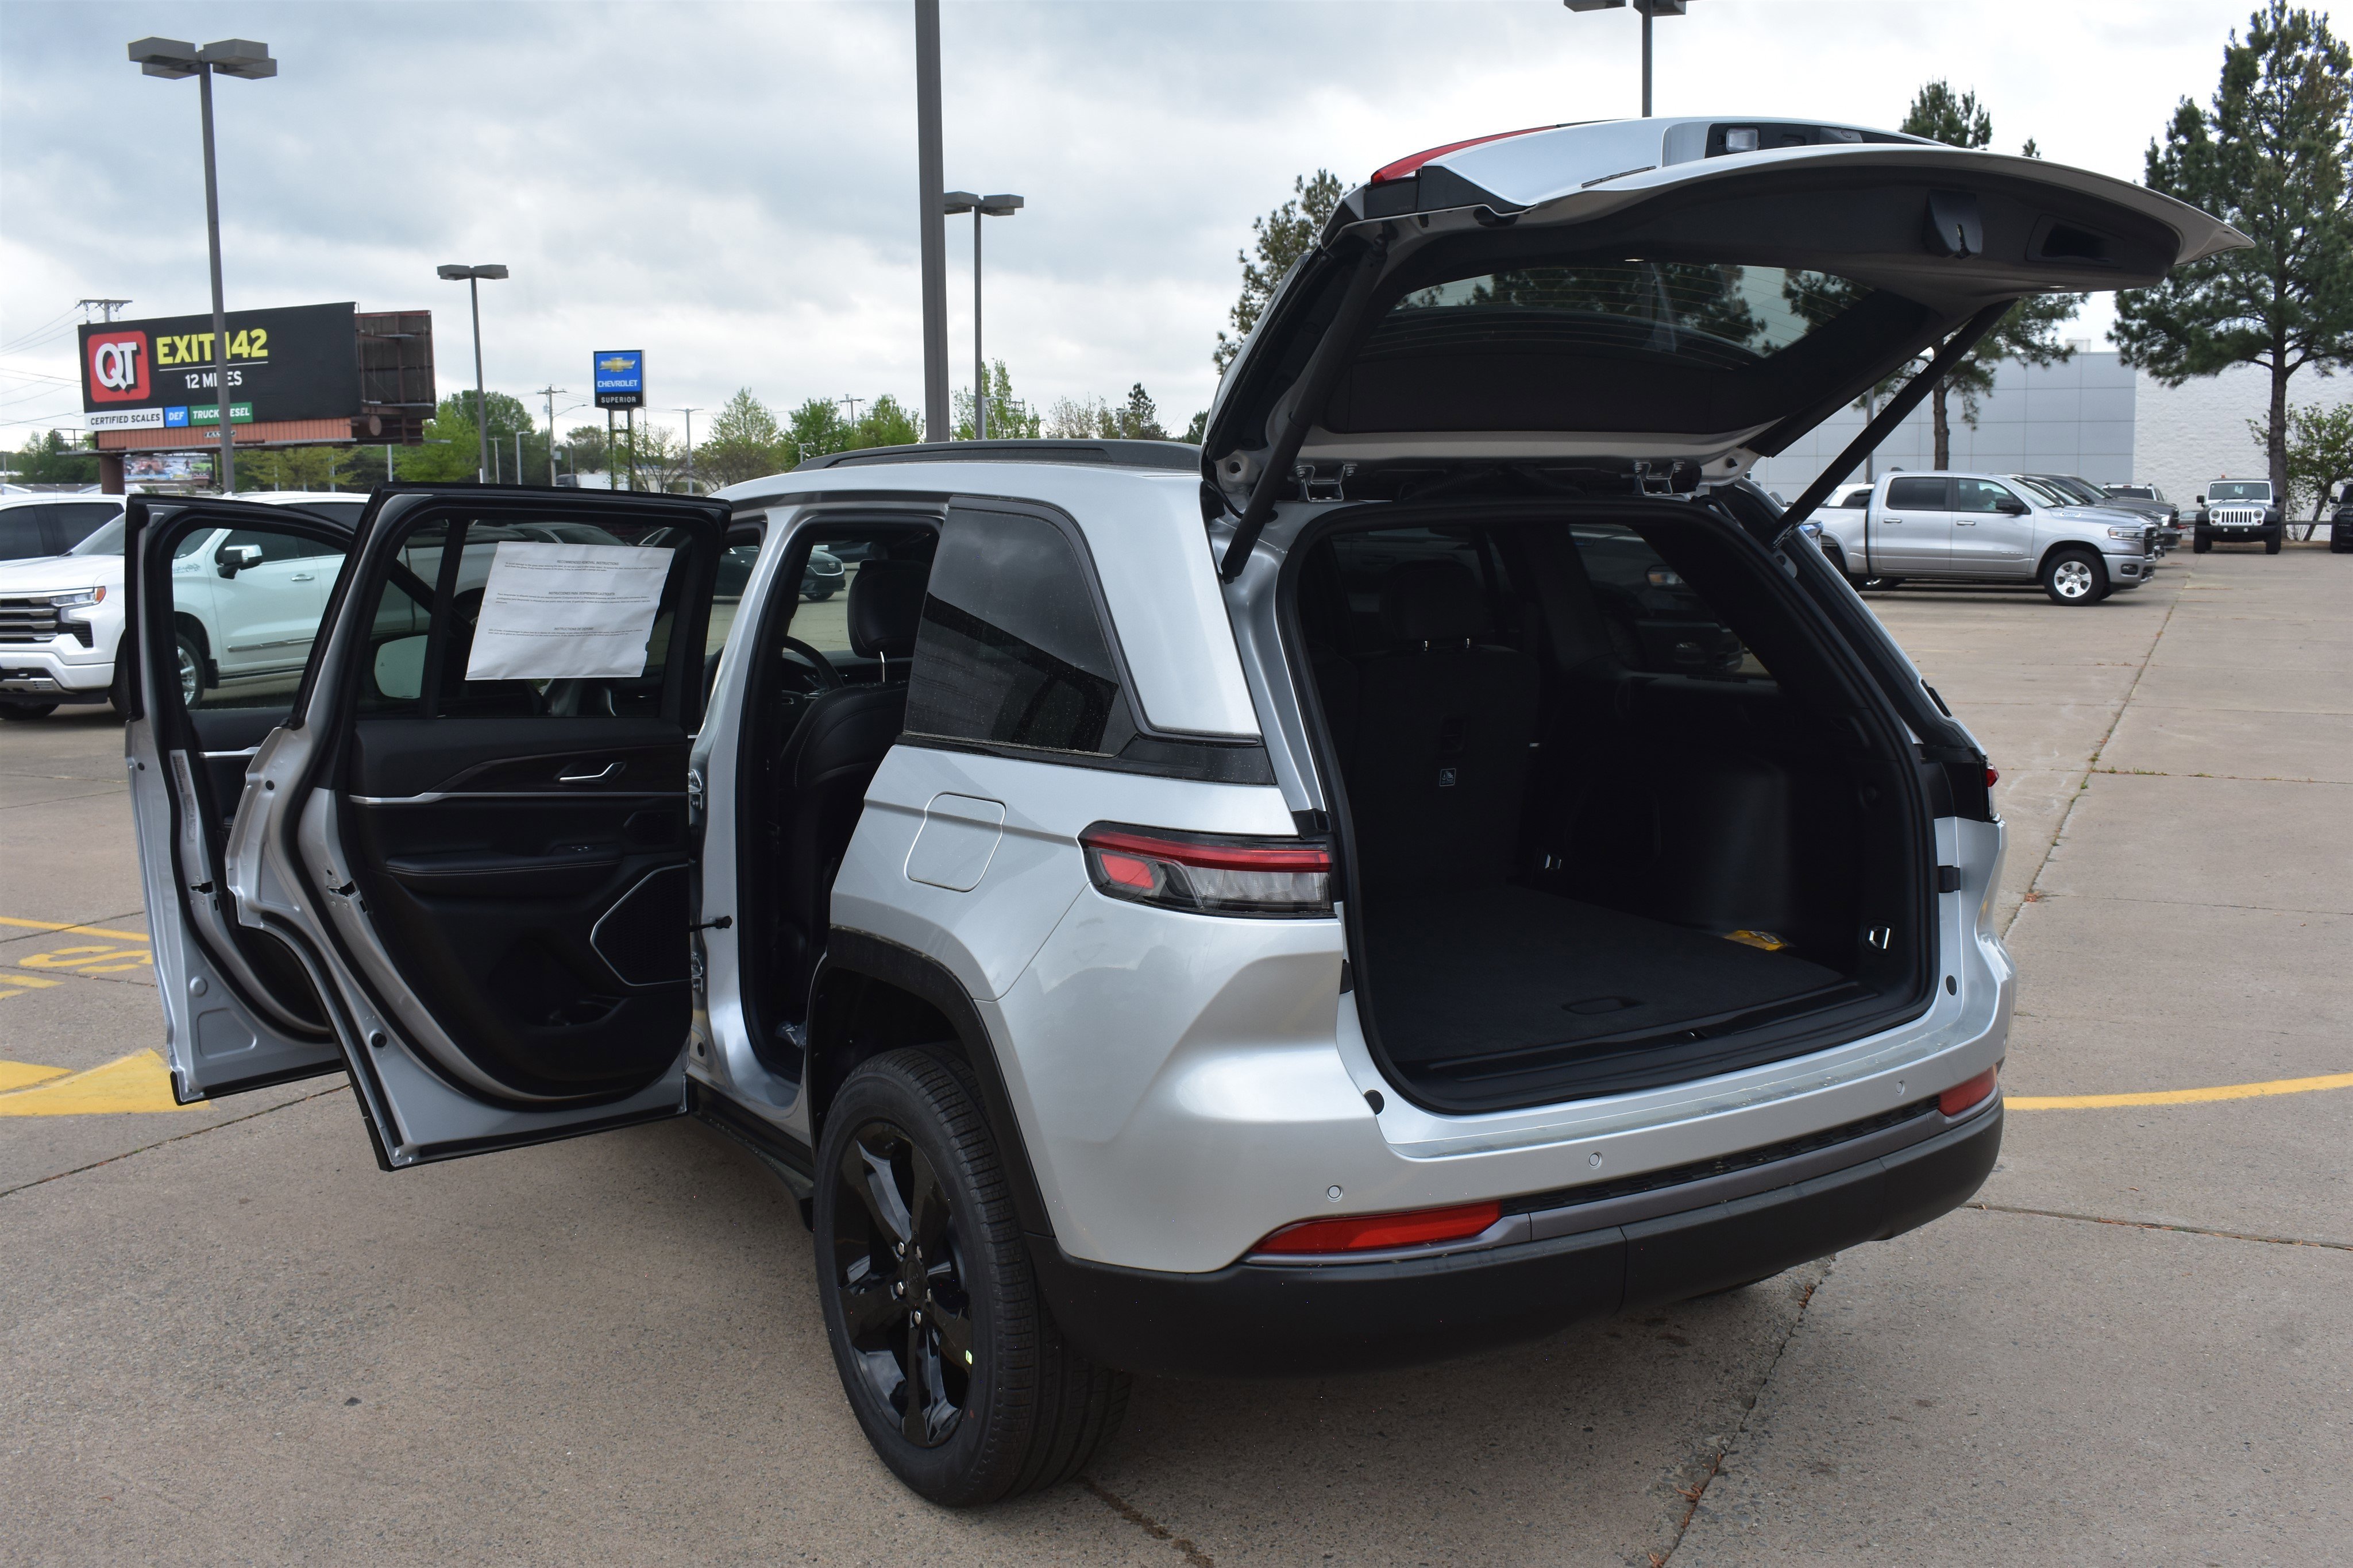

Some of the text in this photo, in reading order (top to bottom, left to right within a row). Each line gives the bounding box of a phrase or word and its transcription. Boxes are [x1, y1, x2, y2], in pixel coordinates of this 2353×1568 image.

[156, 329, 268, 365] EXIT 142
[95, 342, 137, 390] QT
[185, 370, 242, 389] 12 MIES
[597, 379, 638, 387] CHEVROLET
[169, 411, 184, 421] DEF
[193, 407, 250, 419] TRUCK ESEL
[90, 414, 160, 426] CERTIFIED SCALES
